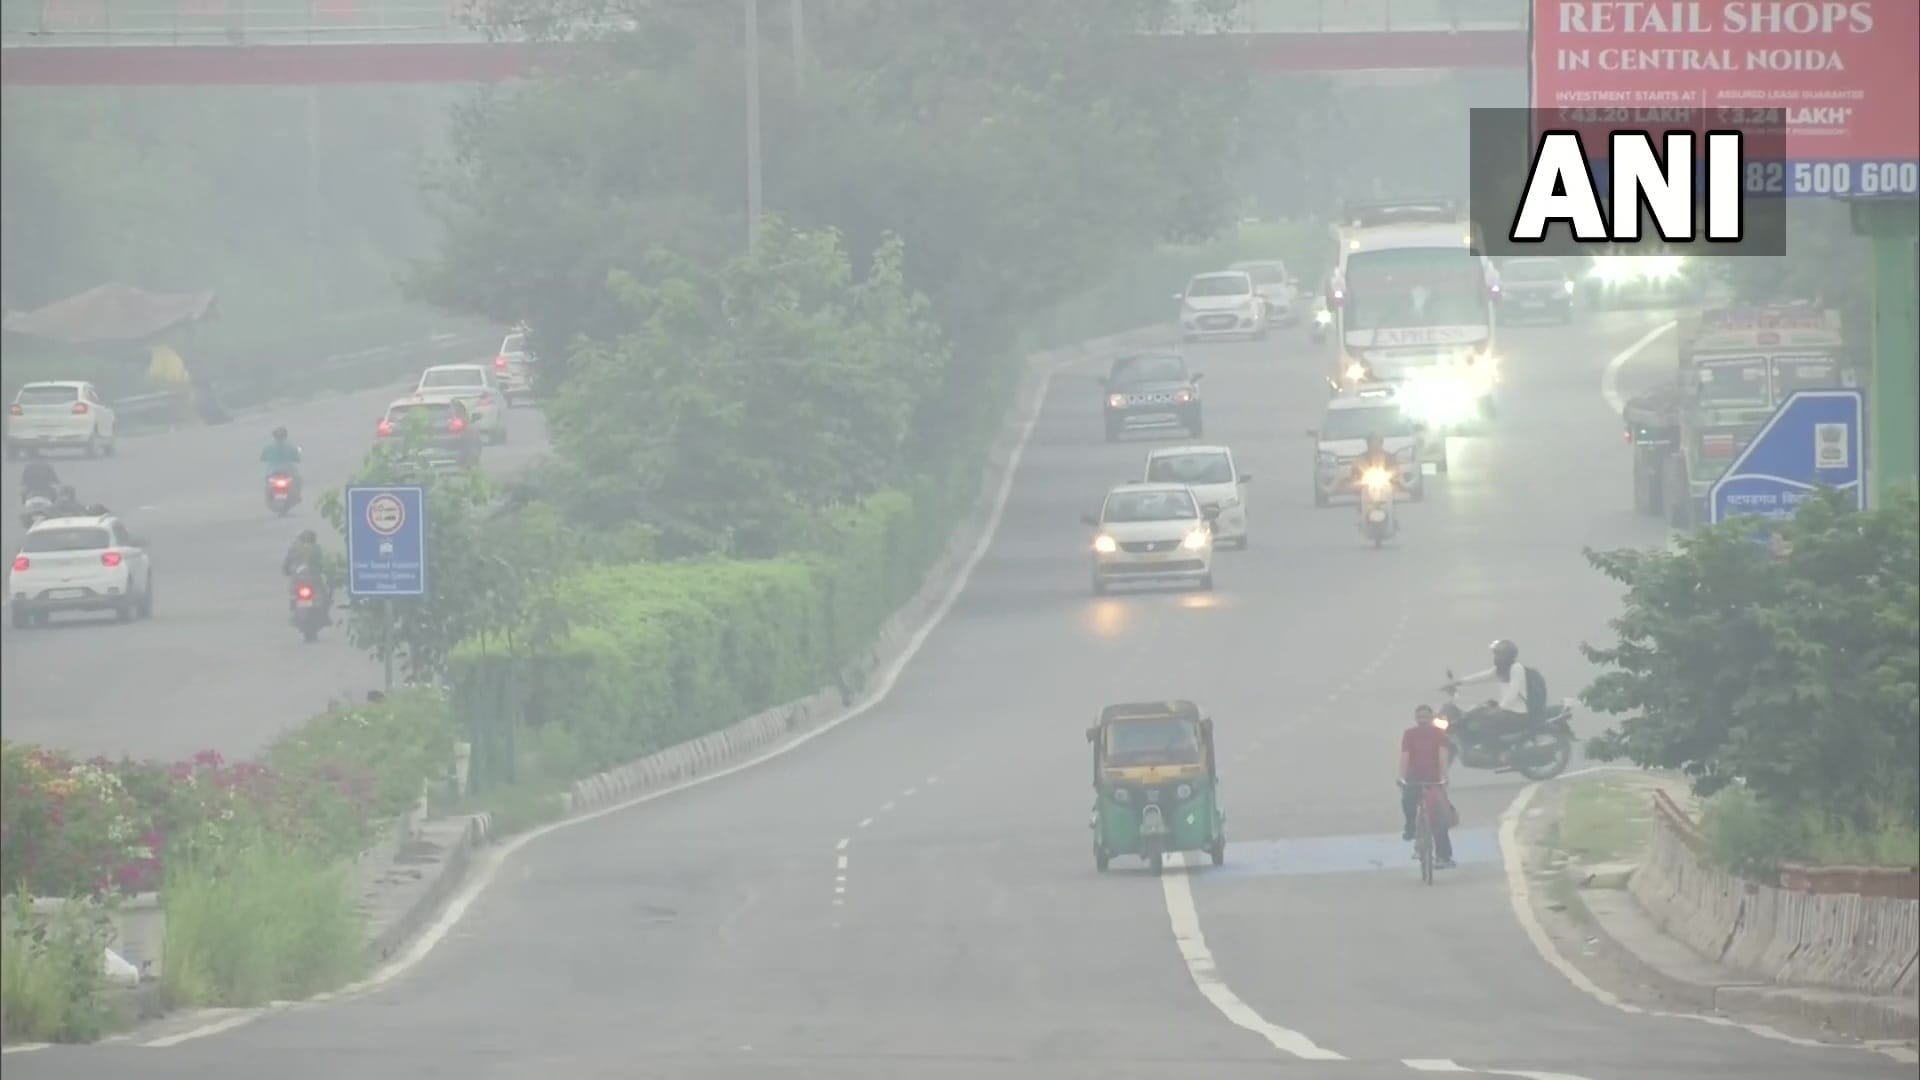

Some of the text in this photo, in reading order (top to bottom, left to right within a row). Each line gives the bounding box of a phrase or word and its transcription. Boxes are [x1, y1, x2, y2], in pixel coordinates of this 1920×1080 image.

[1559, 1, 1874, 33] RETAIL SHOPS
[1557, 49, 1844, 71] IN CENTRAL NOIDA
[1555, 90, 1697, 101] INVESTMENT STARTS AT
[1717, 89, 1765, 99] ASSURED
[1794, 162, 1850, 193] 500
[1861, 162, 1917, 193] 600
